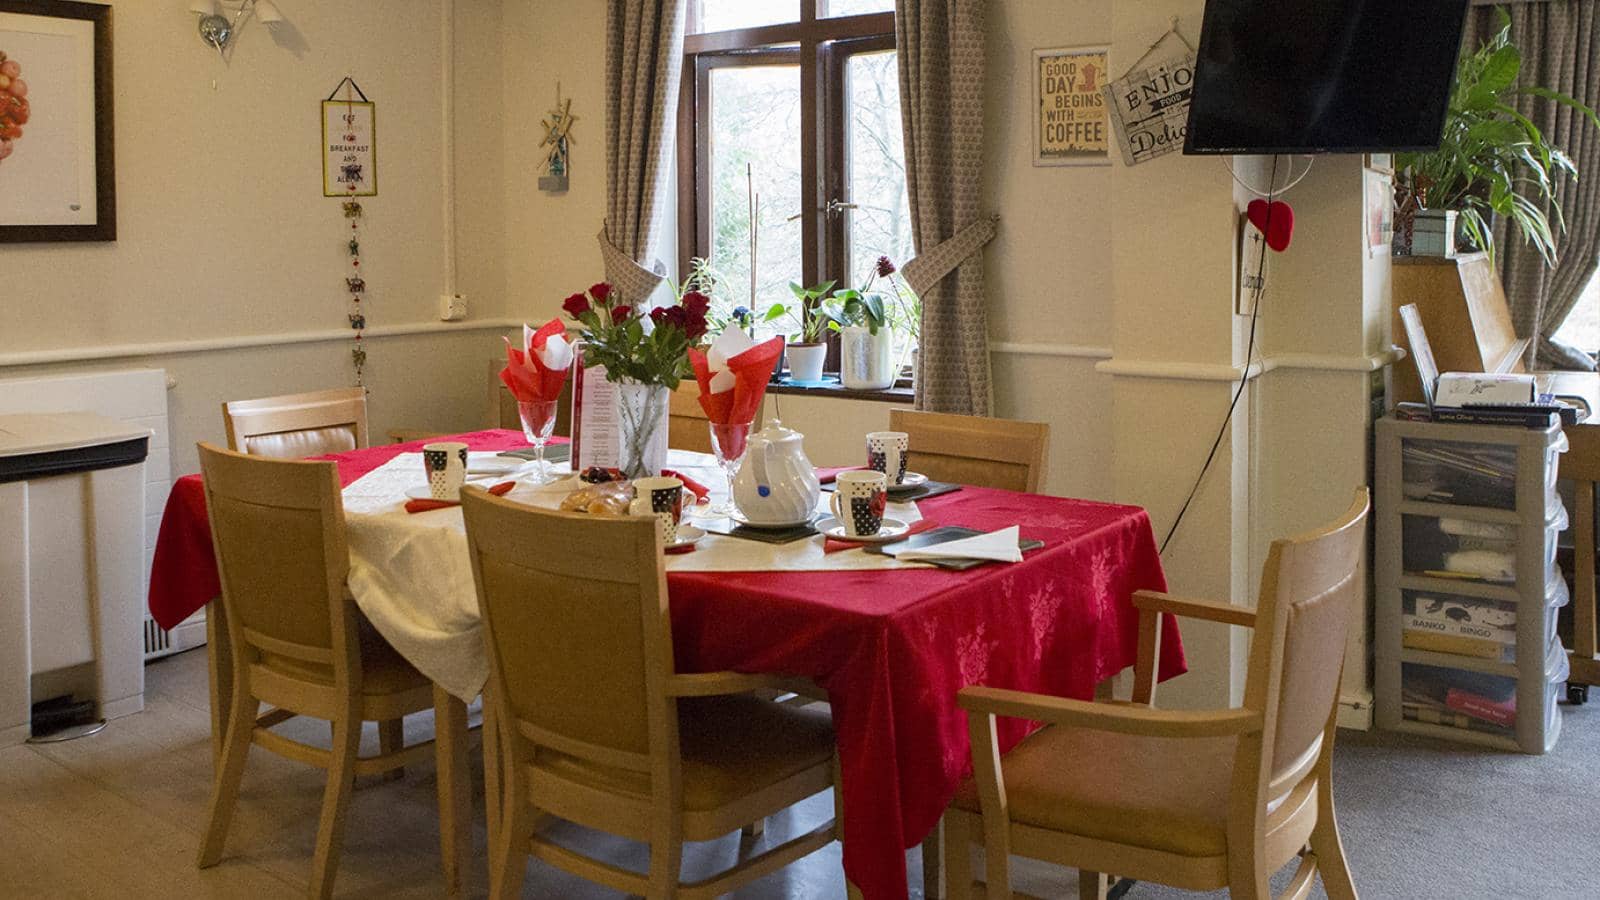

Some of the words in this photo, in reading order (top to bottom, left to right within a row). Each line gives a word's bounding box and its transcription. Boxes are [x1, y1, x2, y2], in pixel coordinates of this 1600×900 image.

[1046, 63, 1076, 76] GOOD
[1046, 76, 1076, 94] DAY
[1055, 93, 1103, 108] BEGINS
[1160, 94, 1182, 106] FOOD
[1046, 110, 1074, 121] WITH
[1046, 122, 1103, 143] COFFEE
[330, 144, 369, 152] BREAKFAST
[1412, 619, 1446, 631] BANKO
[1460, 626, 1492, 638] BINGO
